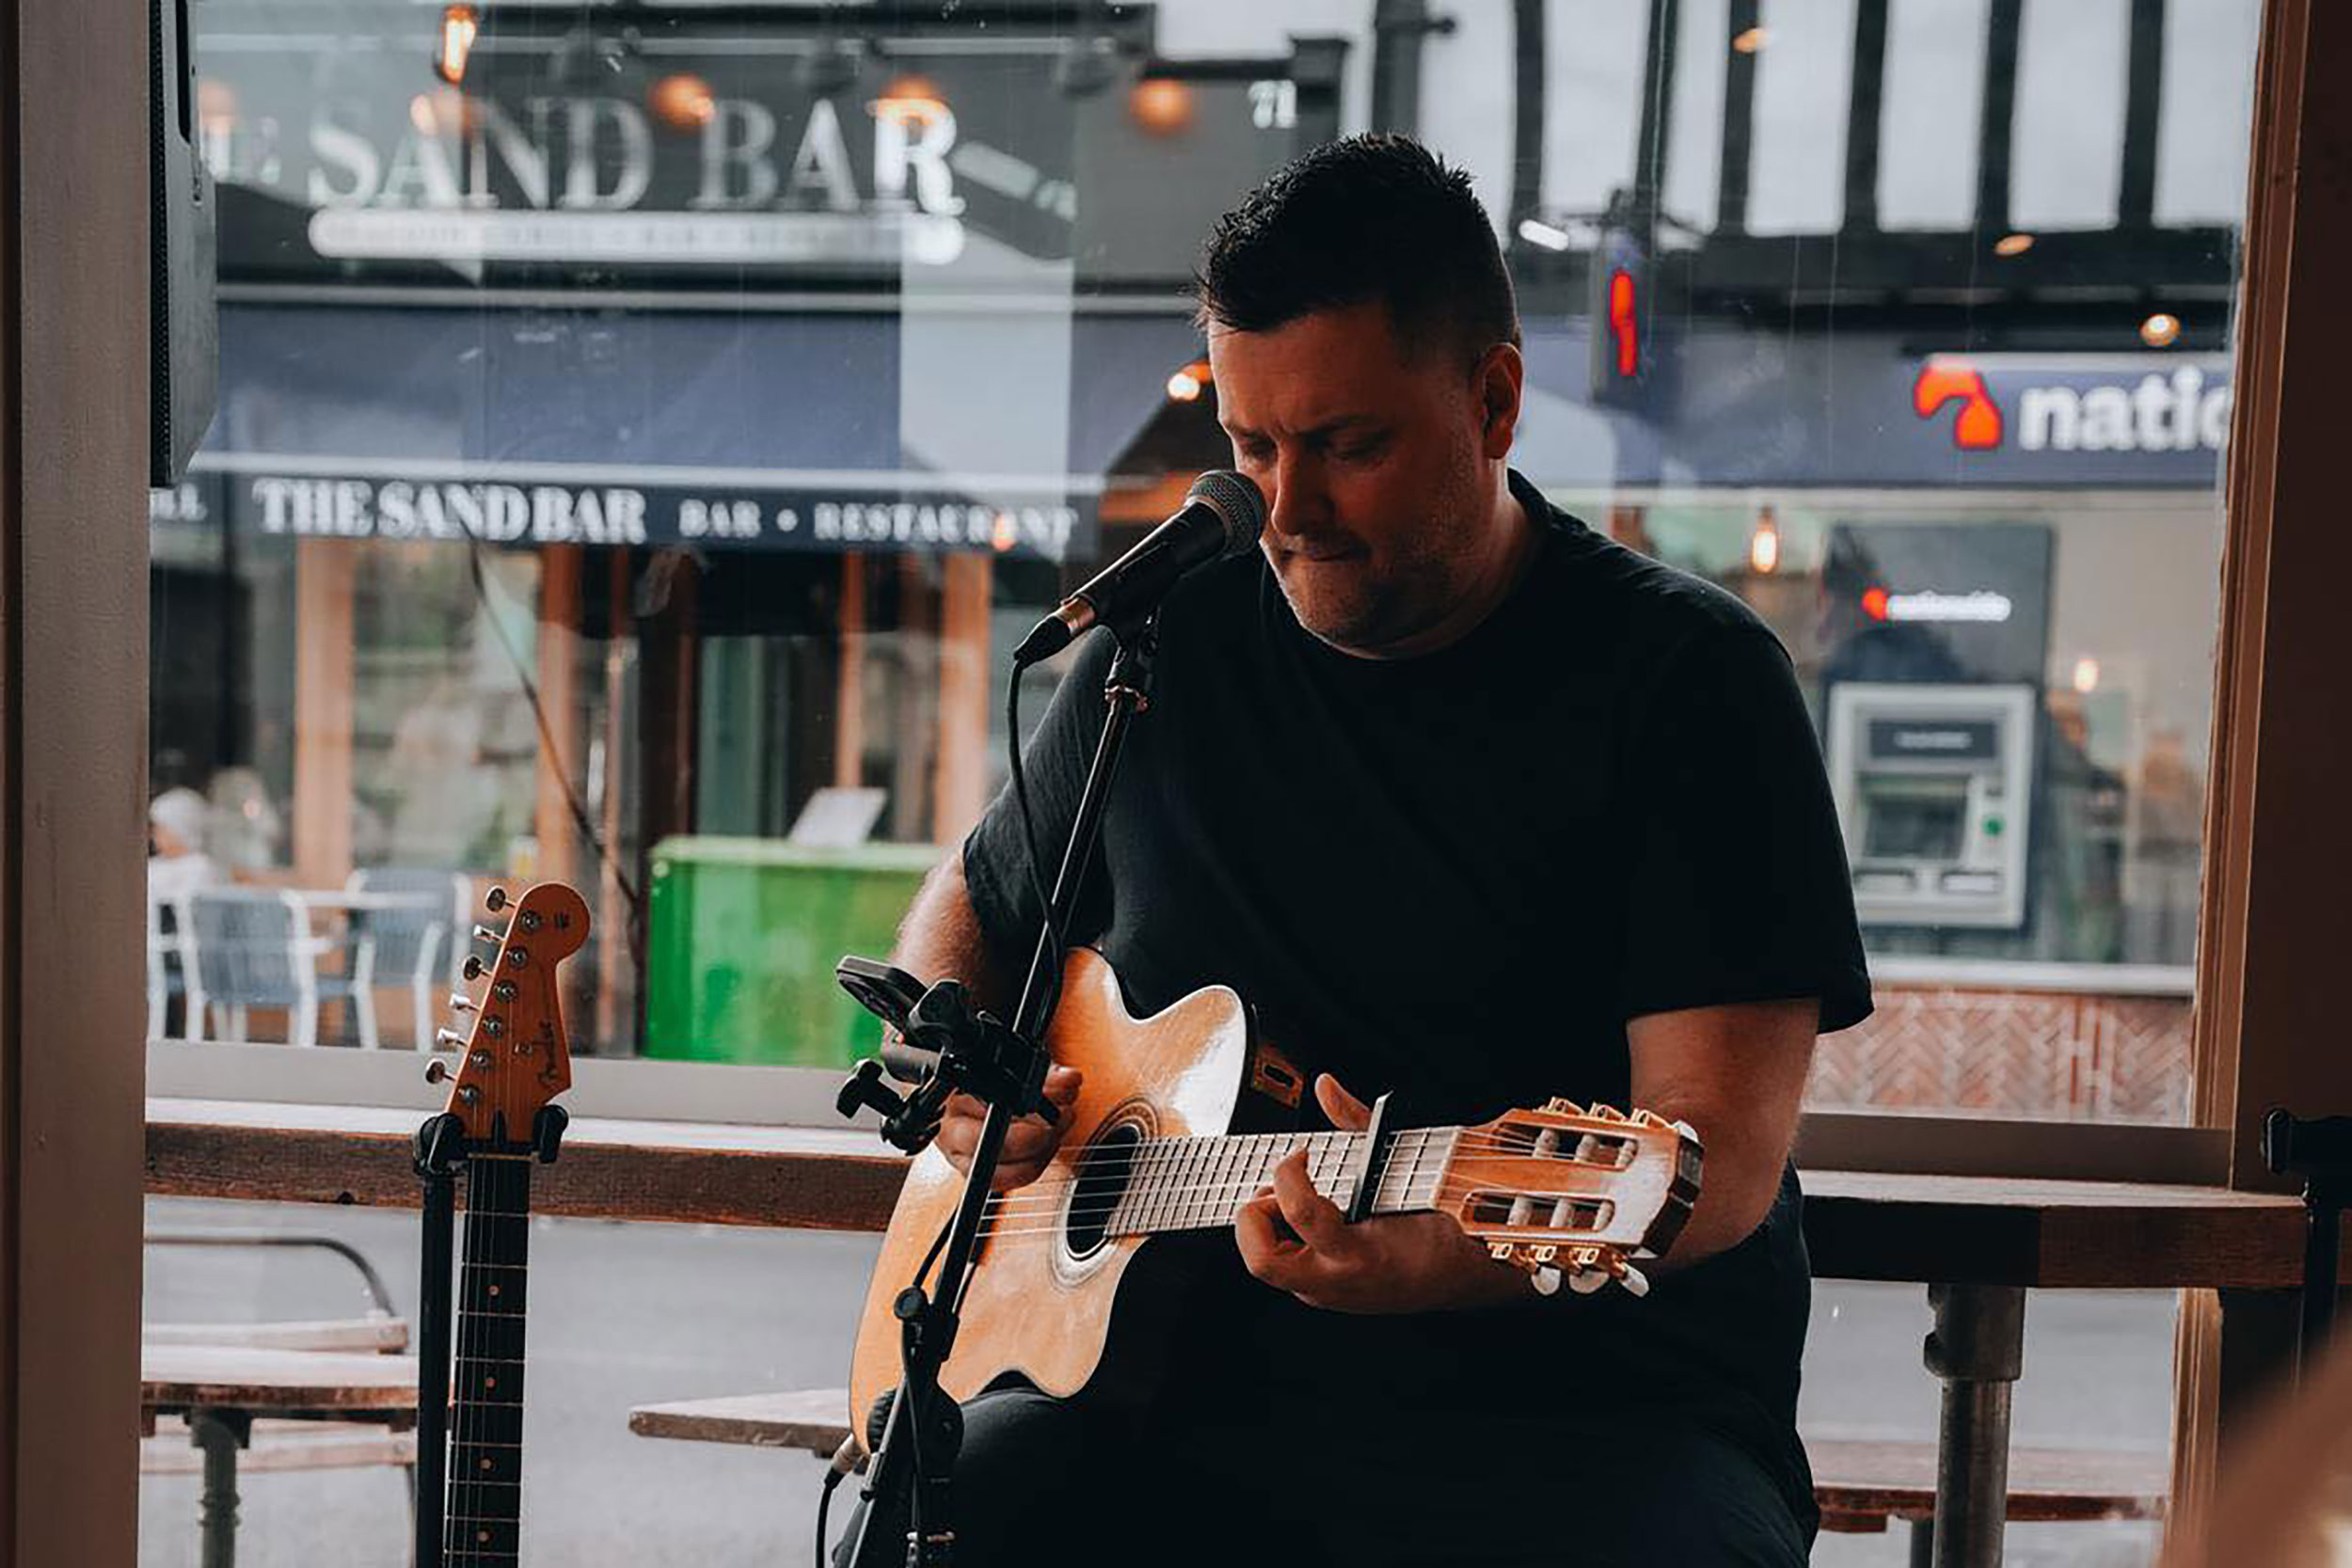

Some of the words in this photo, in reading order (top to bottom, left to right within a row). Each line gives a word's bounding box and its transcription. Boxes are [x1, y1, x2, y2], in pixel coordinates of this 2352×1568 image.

[1248, 79, 1297, 129] 71
[307, 95, 653, 212] SAND
[687, 97, 965, 217] BAR
[252, 476, 374, 537] THE
[378, 480, 530, 540] SAND
[532, 487, 646, 544] BAR
[678, 499, 761, 539] BAR
